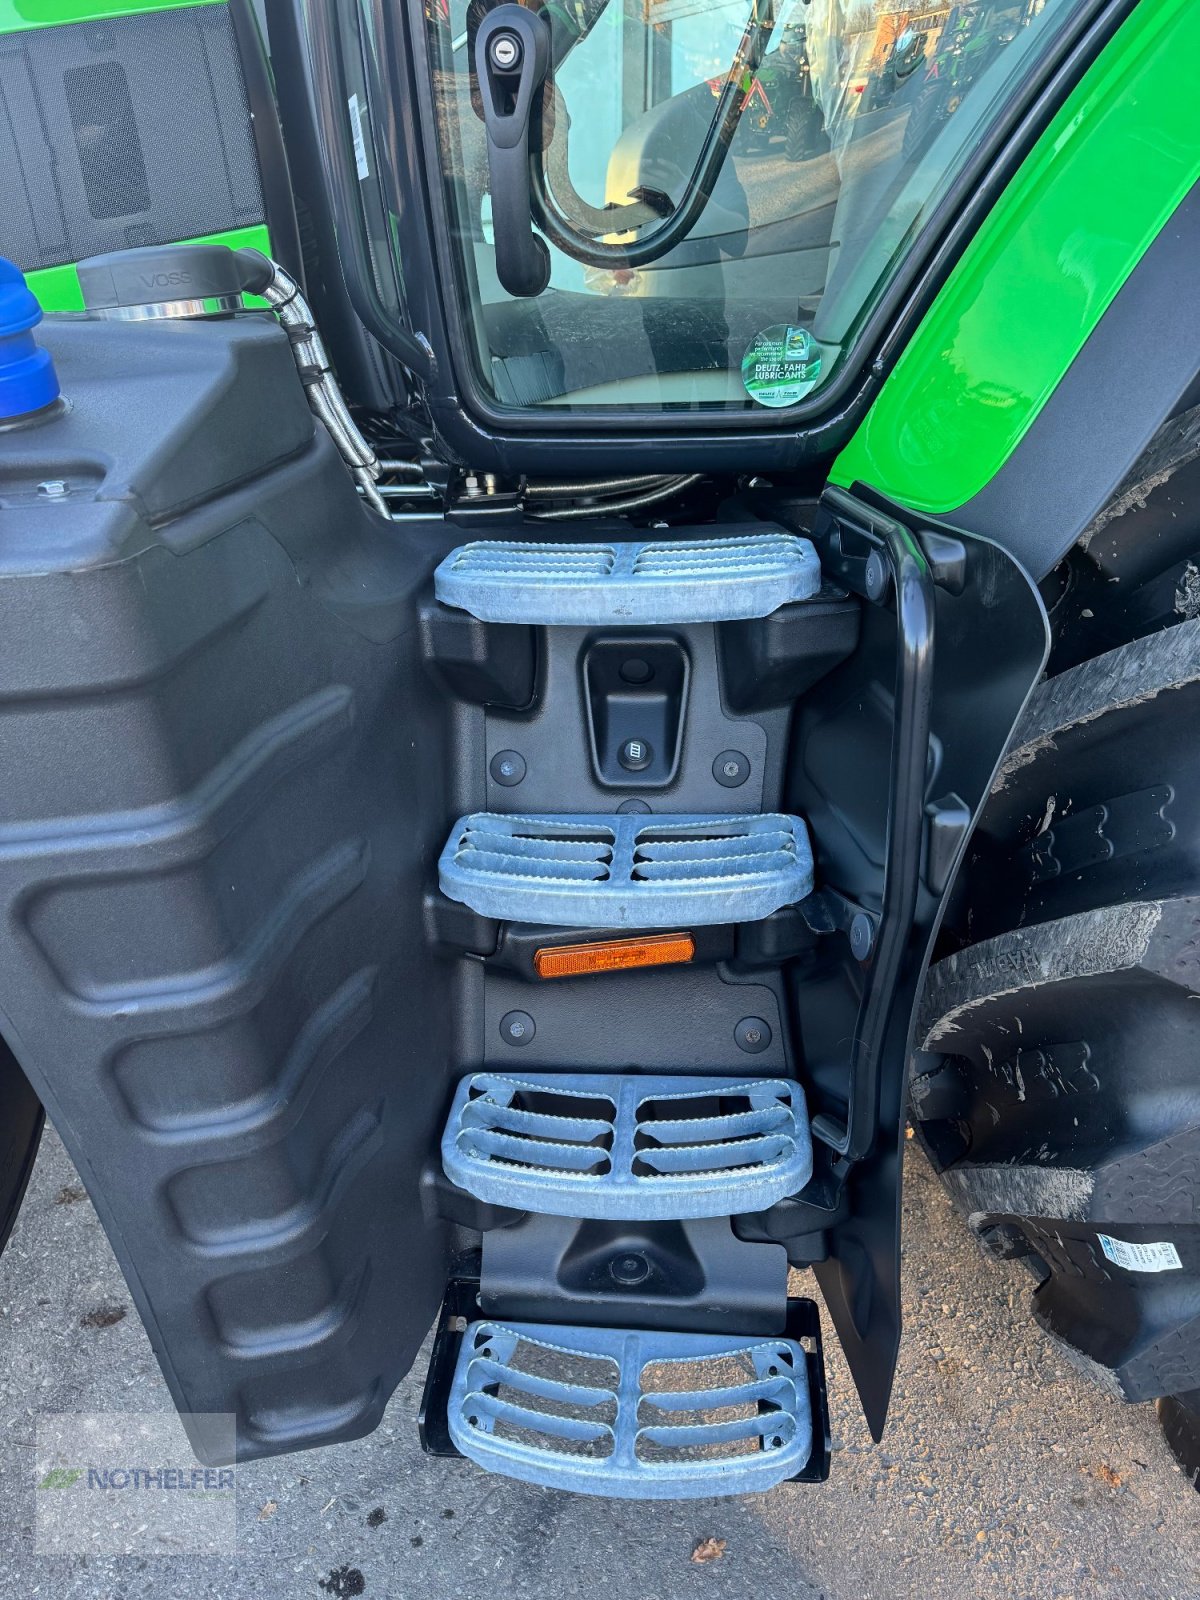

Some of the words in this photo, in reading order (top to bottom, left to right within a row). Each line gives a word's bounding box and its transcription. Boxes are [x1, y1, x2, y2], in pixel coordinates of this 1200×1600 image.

[139, 271, 192, 288] VOSS
[755, 363, 807, 372] DEUTZ-FAHR
[754, 371, 806, 380] LUBRICANTS
